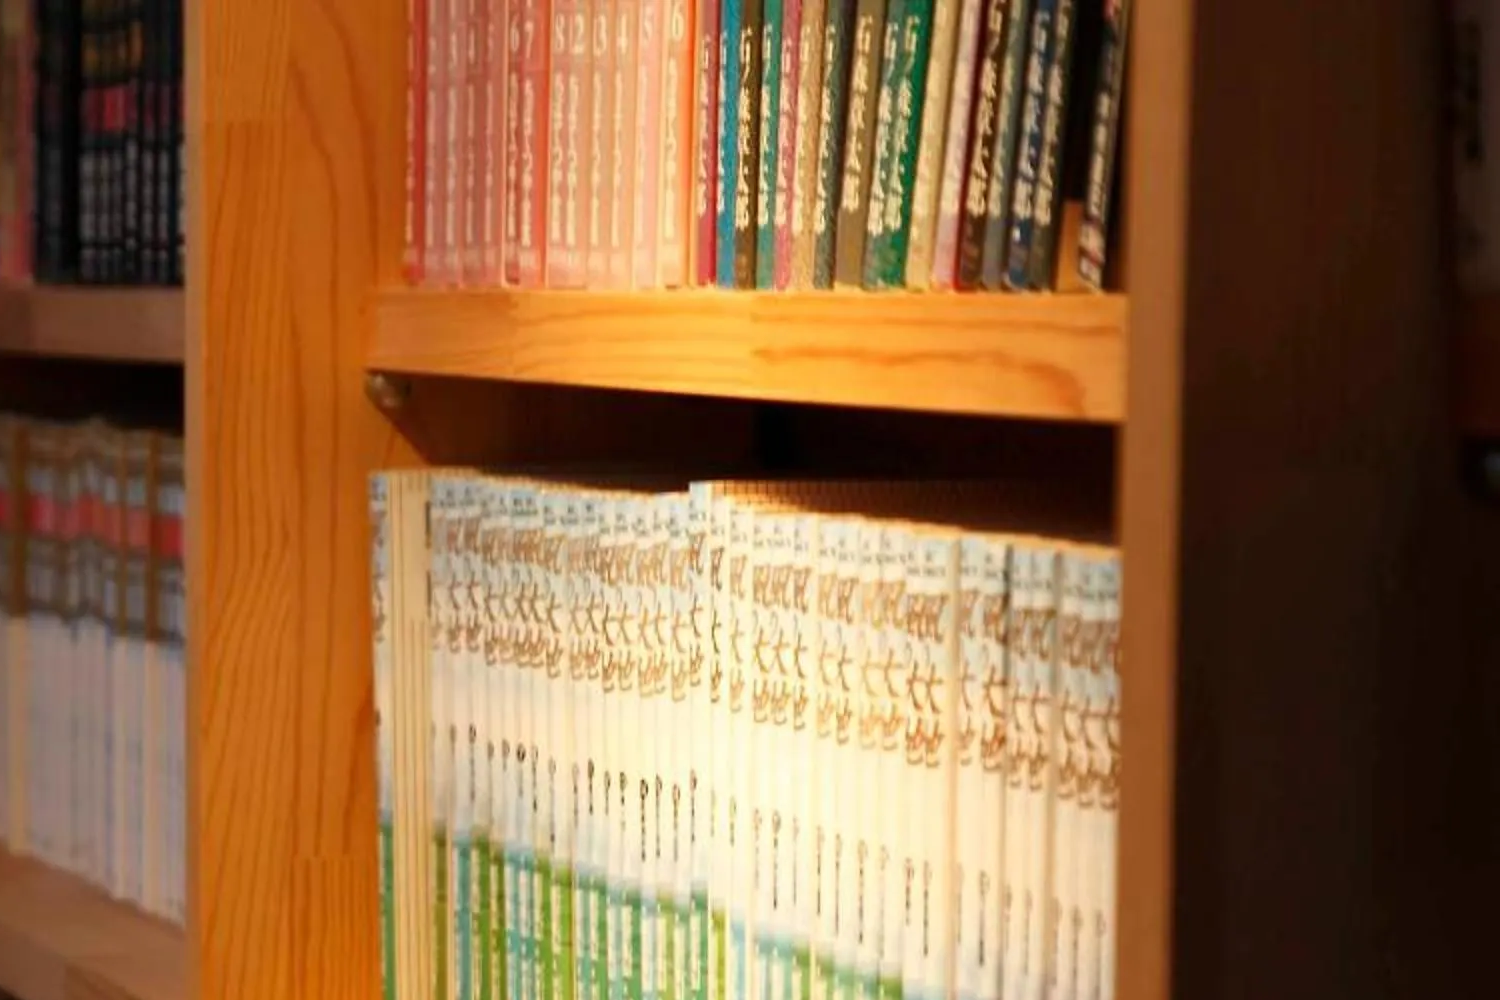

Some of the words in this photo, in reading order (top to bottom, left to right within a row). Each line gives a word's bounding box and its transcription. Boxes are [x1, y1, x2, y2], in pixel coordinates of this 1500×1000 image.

[510, 13, 519, 53] 6
[524, 20, 534, 59] 7
[555, 13, 565, 54] 8
[573, 13, 585, 55] 2
[594, 13, 607, 56] 3
[672, 2, 684, 42] 6
